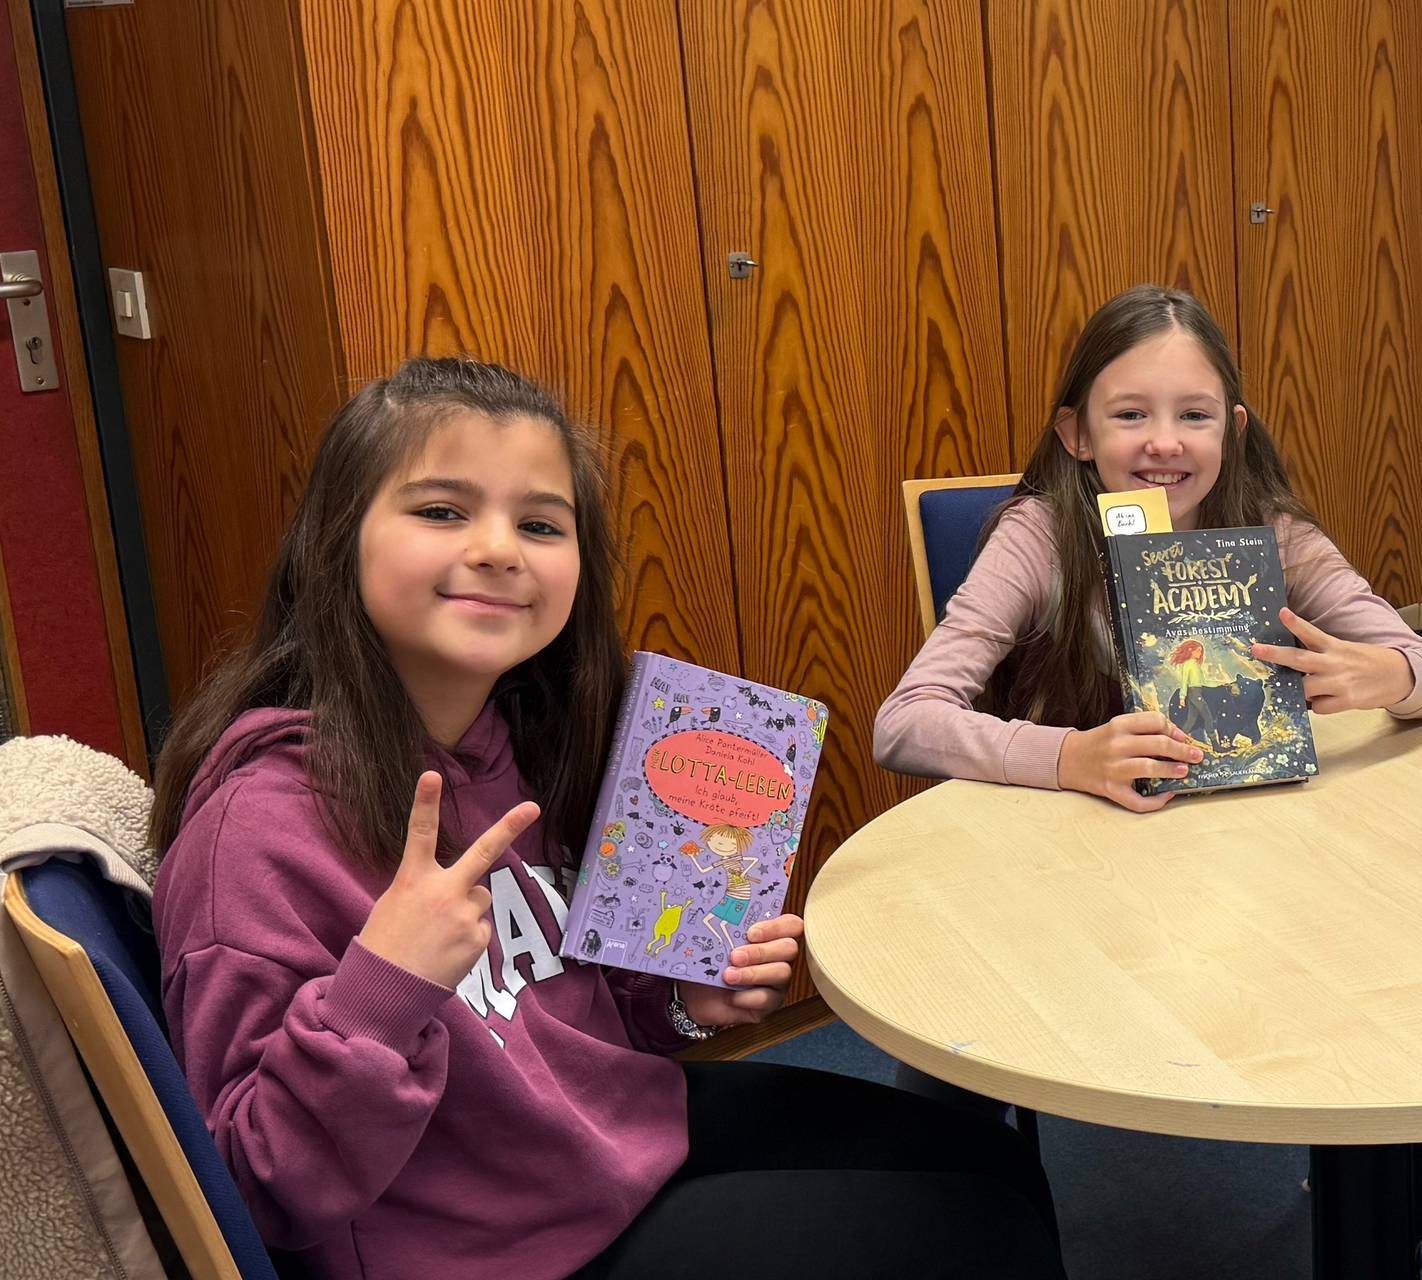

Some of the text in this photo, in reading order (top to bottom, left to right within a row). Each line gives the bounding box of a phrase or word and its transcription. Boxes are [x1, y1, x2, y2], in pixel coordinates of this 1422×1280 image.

[1141, 541, 1184, 567] Secret
[1216, 538, 1263, 548] Tina Stein
[1162, 555, 1231, 582] FOREST
[1151, 573, 1257, 615] ACADEMY
[1165, 624, 1249, 638] Avas Bestimmung
[696, 733, 768, 758] Alice Pantermüller
[705, 745, 755, 766] Daniela Kohl
[659, 751, 791, 800] LOTTA-LEBEN
[668, 794, 760, 821] meine Kröte pfeift!
[696, 785, 738, 805] Ich glaub,
